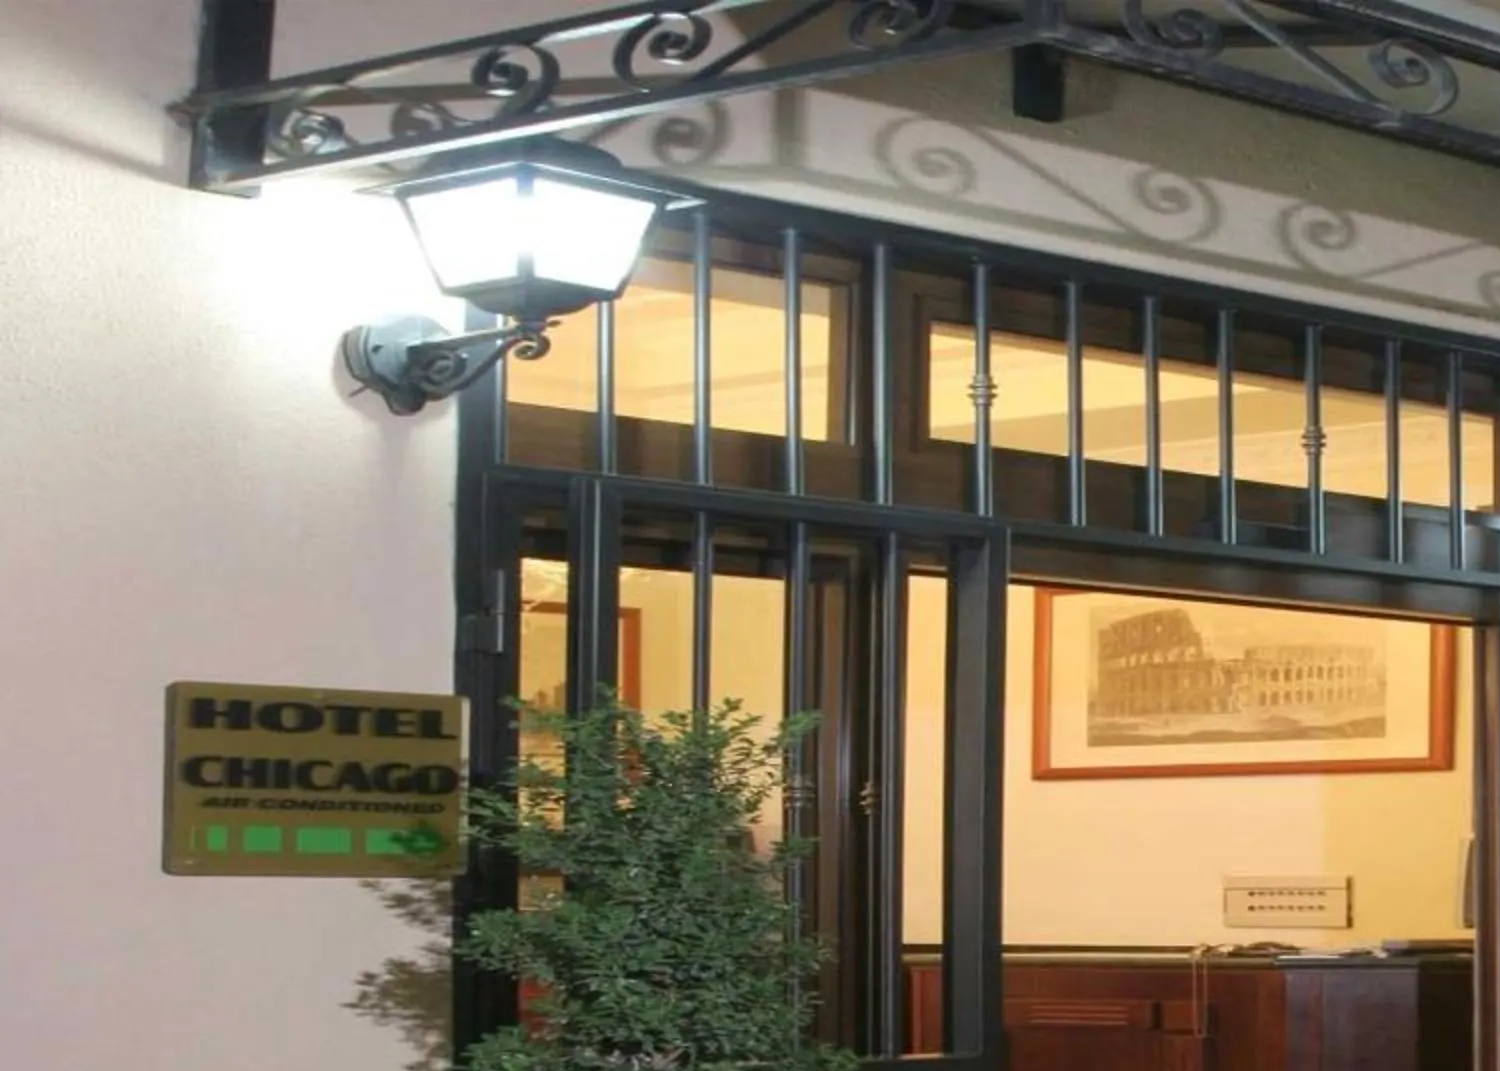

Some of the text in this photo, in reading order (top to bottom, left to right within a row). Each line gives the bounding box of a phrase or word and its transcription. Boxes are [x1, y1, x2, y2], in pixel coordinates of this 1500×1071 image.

[190, 697, 458, 740] HOTEL
[182, 756, 462, 795] CHICAGO
[201, 796, 446, 814] AIR CONDITIONED
